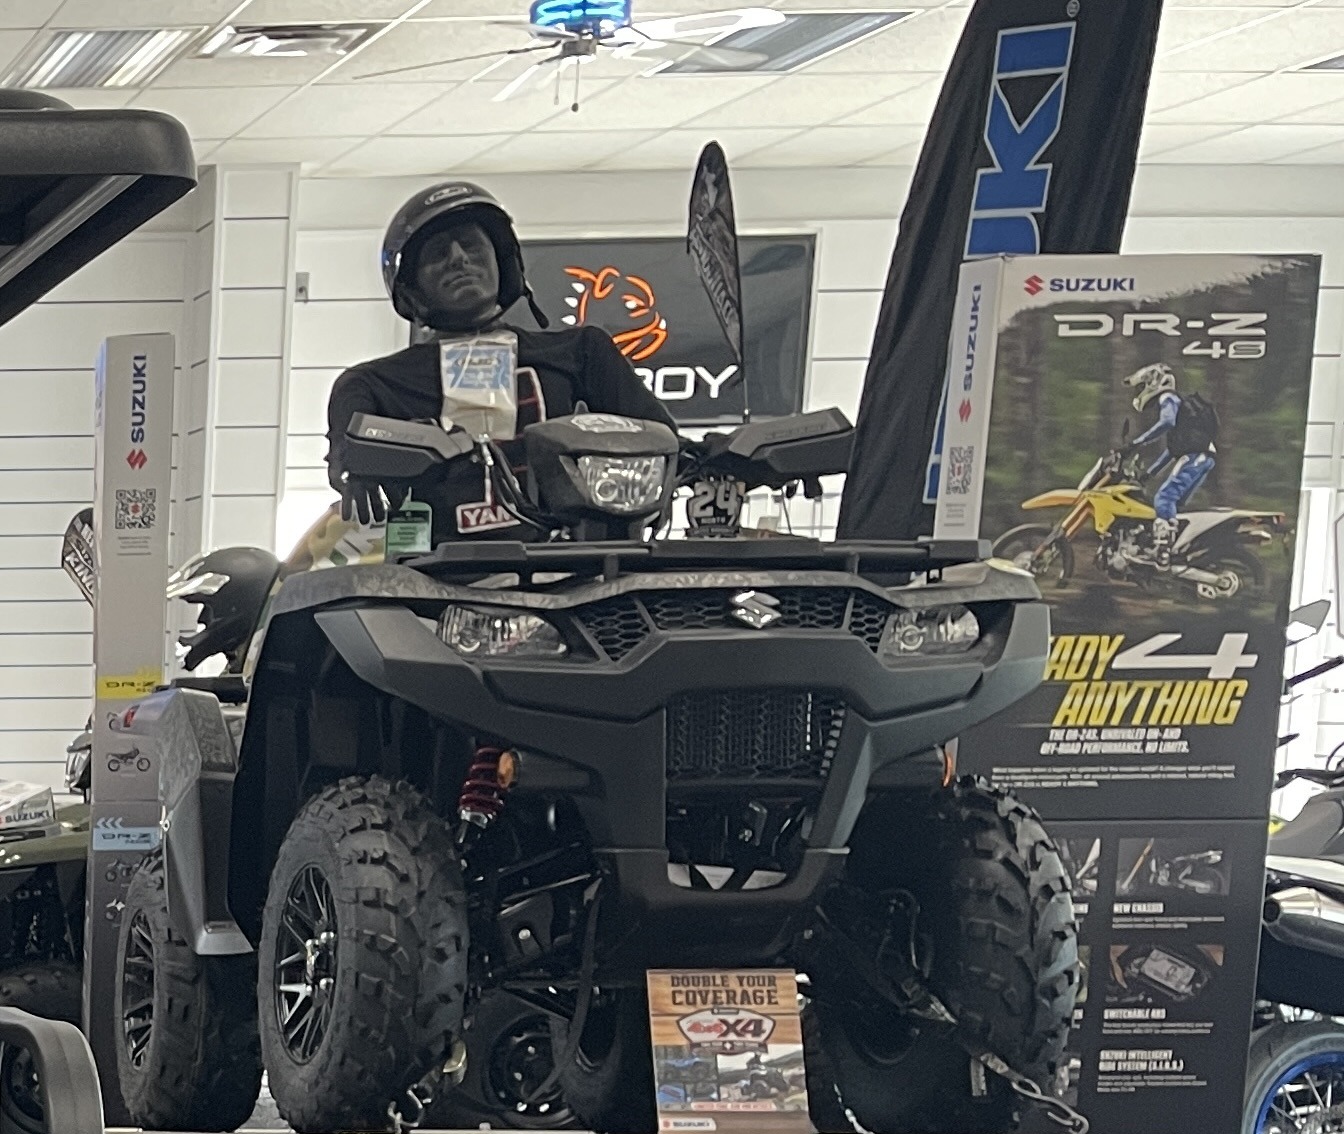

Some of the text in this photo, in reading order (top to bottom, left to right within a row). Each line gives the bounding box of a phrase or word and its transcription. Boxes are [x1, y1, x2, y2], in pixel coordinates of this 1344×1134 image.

[1049, 278, 1135, 292] SUZUKI
[963, 284, 981, 392] SUZUKI
[1053, 312, 1268, 338] DR-Z
[130, 355, 148, 443] SUZUKI
[693, 481, 737, 517] 24
[1042, 633, 1259, 681] ADY 4
[1051, 680, 1249, 728] ANYTHING
[4, 811, 50, 824] SUZUKI
[670, 975, 777, 988] DOUBLE YOUR
[671, 989, 779, 1006] COVERAGE
